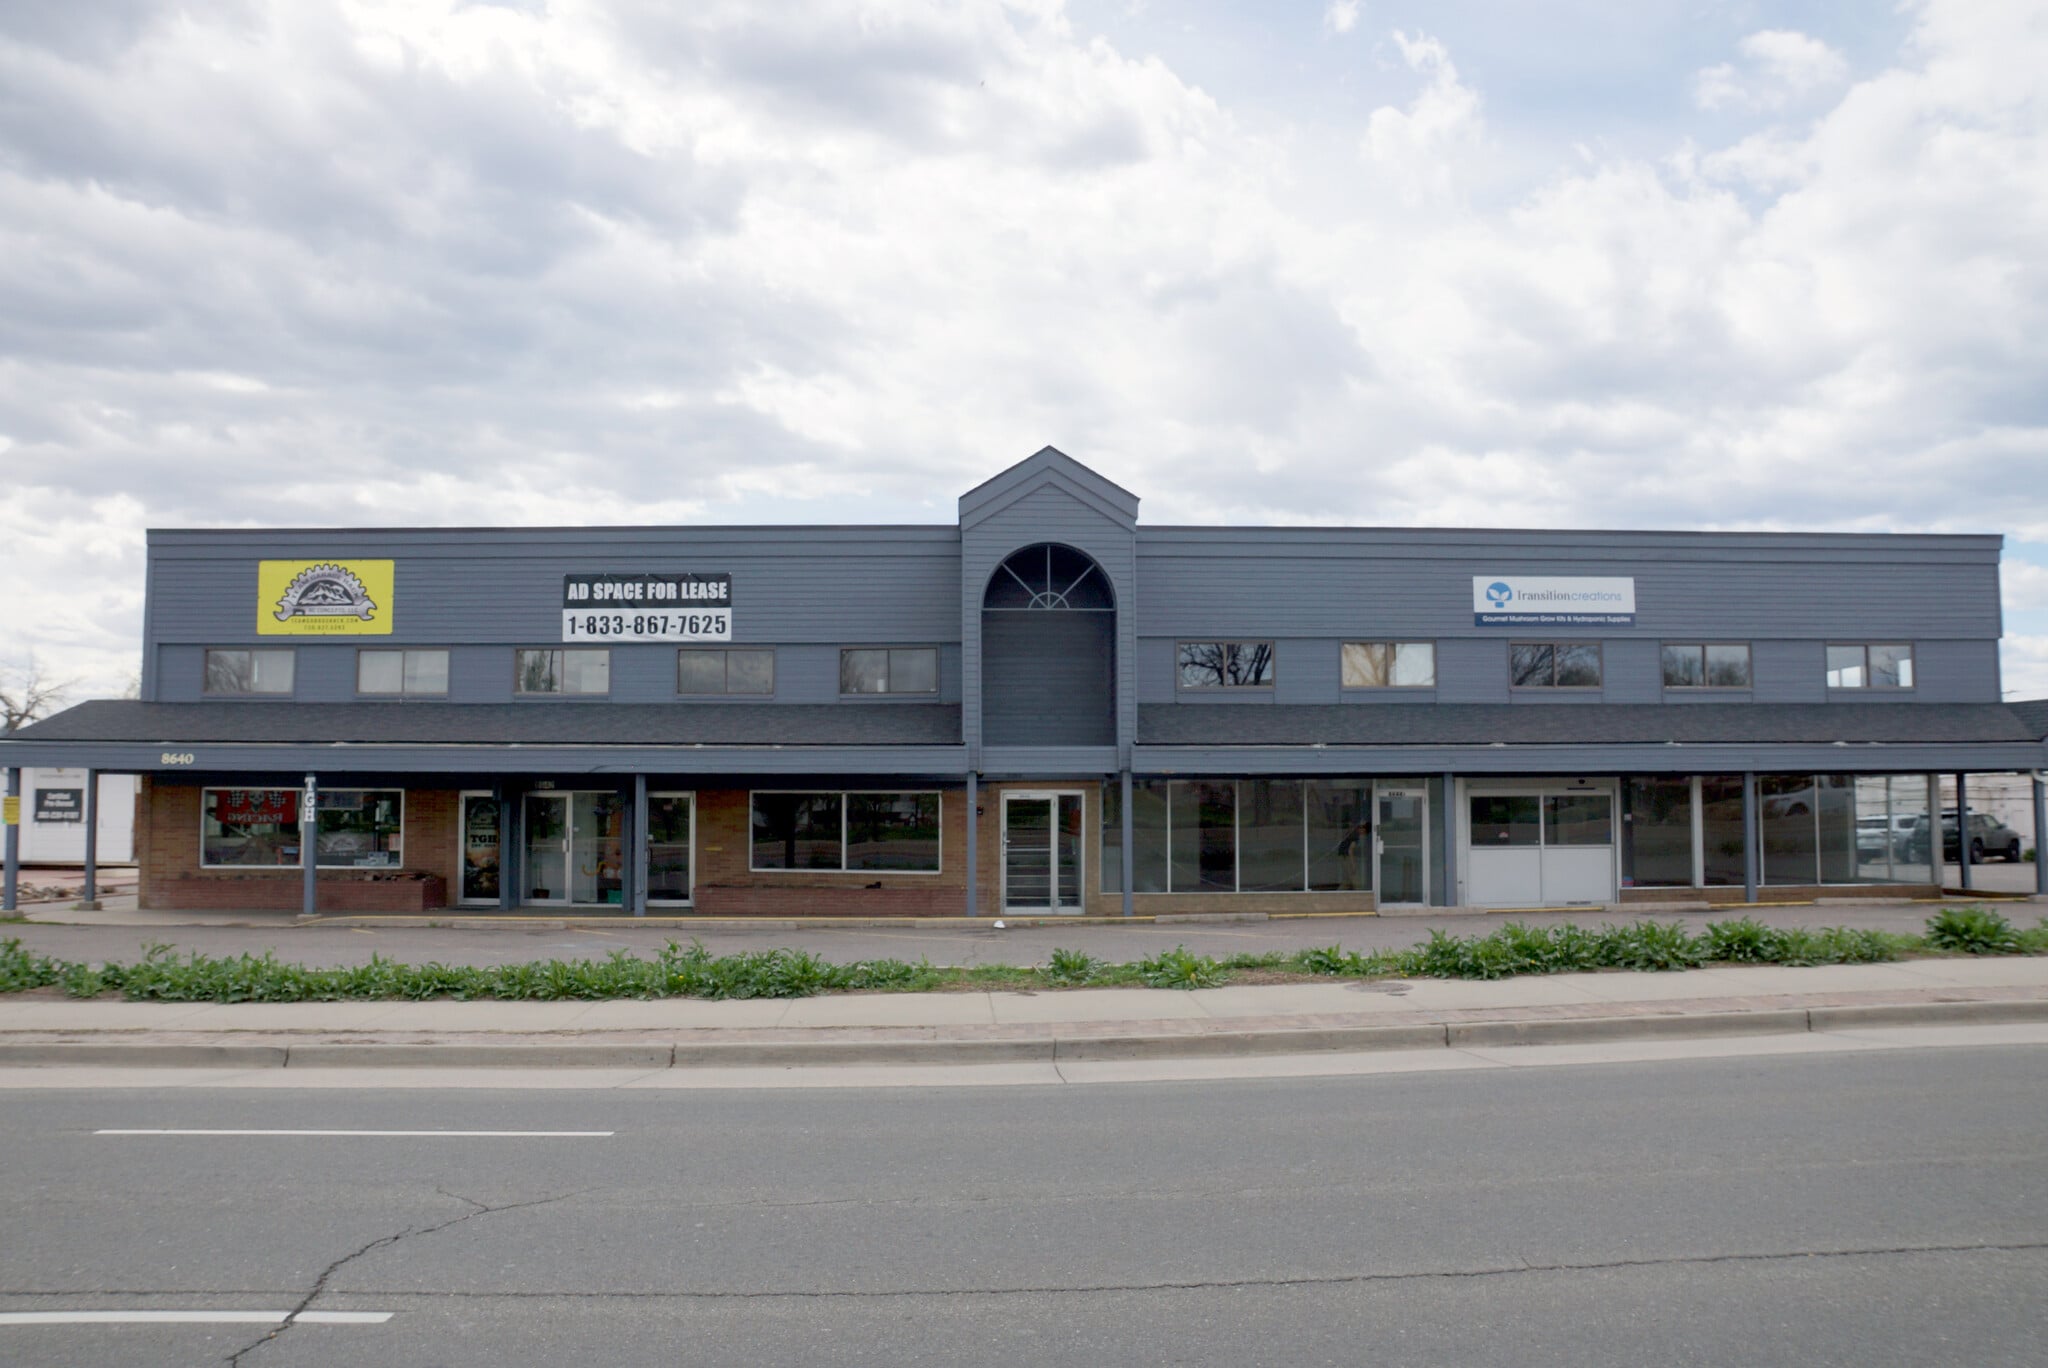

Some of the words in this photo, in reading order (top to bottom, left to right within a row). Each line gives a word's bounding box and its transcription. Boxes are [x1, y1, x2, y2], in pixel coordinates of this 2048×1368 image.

[568, 583, 589, 600] AD
[593, 583, 643, 600] SPACE
[647, 583, 677, 600] FOR
[681, 582, 728, 600] LEASE
[568, 615, 727, 635] 1-833-867-7625
[1482, 615, 1508, 623] Gourmet
[1509, 615, 1539, 623] Mushroom
[1540, 615, 1555, 623] Grow
[1573, 615, 1605, 625] Hydroponic
[1607, 615, 1631, 625] Supplies
[161, 752, 195, 765] 8640
[304, 776, 316, 822] TGH
